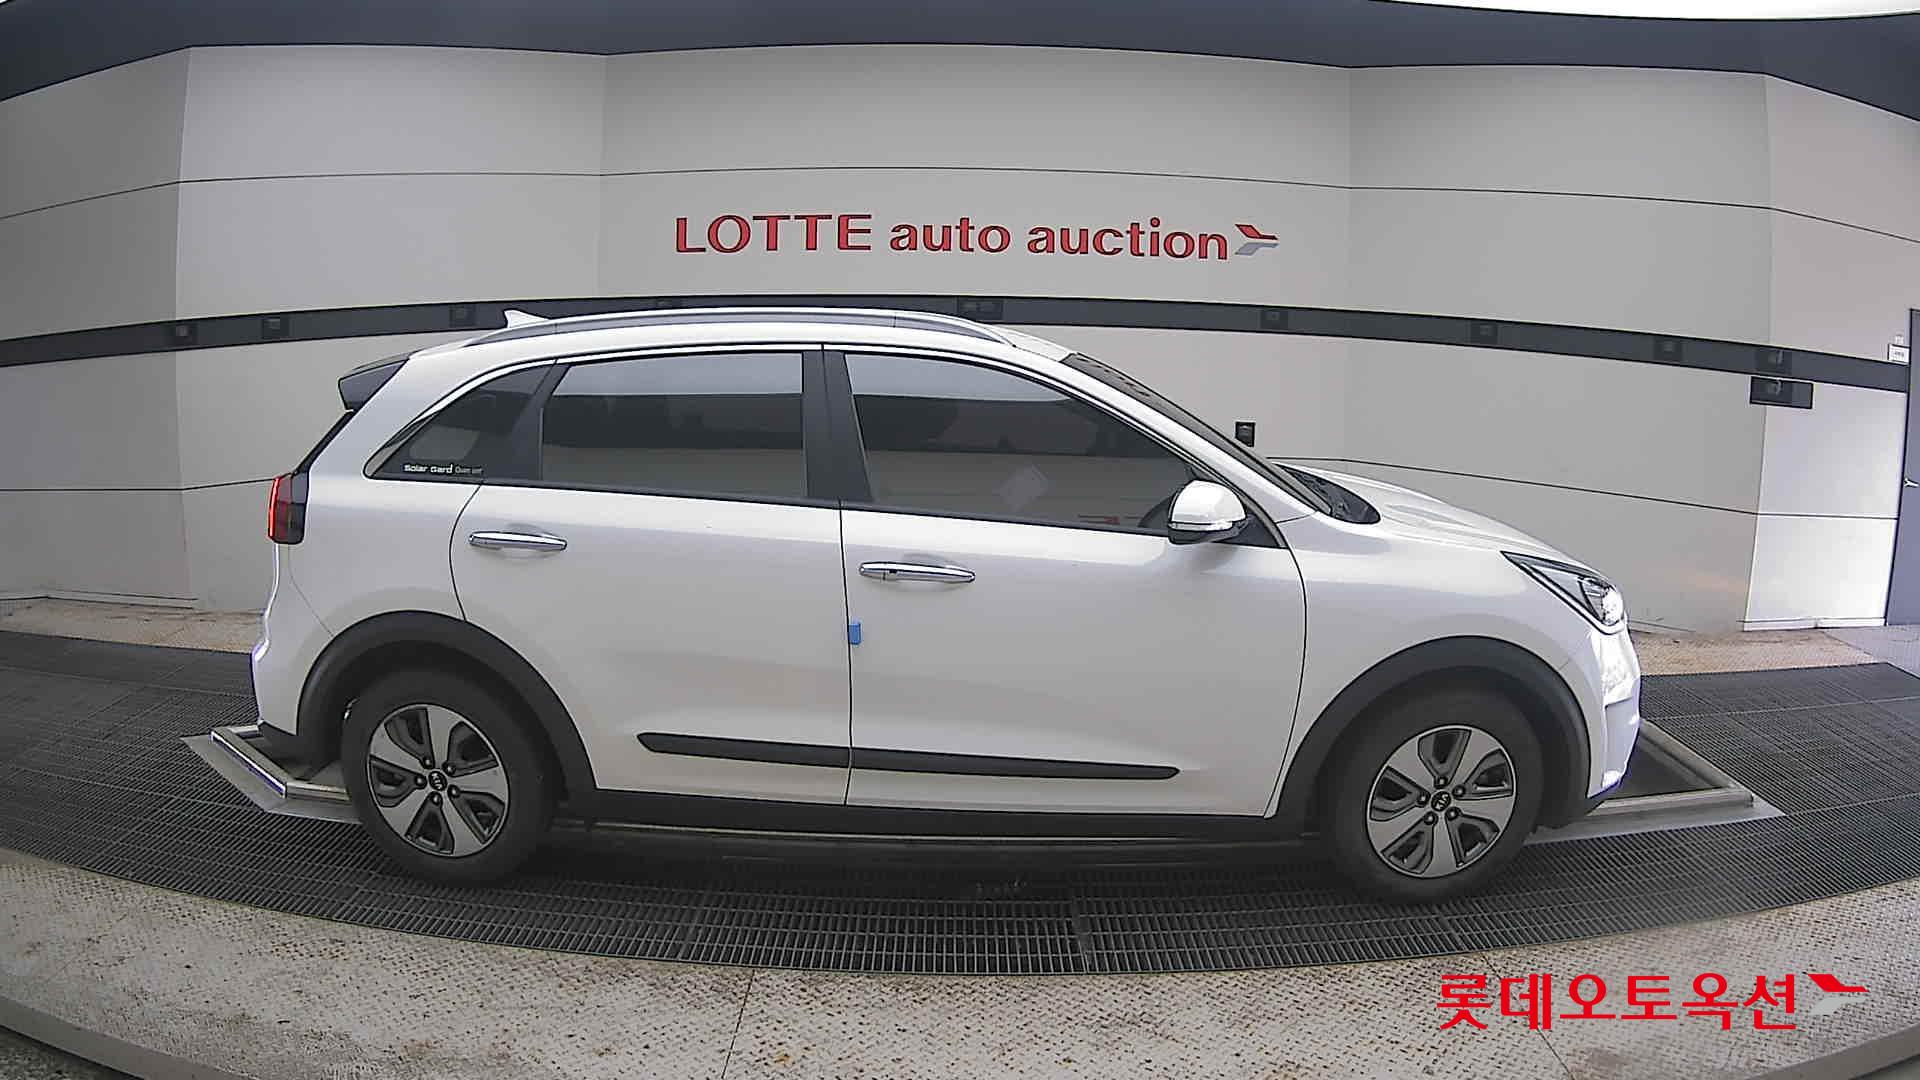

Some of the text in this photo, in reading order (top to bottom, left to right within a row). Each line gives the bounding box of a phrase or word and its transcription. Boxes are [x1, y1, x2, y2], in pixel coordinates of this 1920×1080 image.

[675, 213, 1229, 261] LOTTE auto auction
[403, 464, 428, 473] Solar
